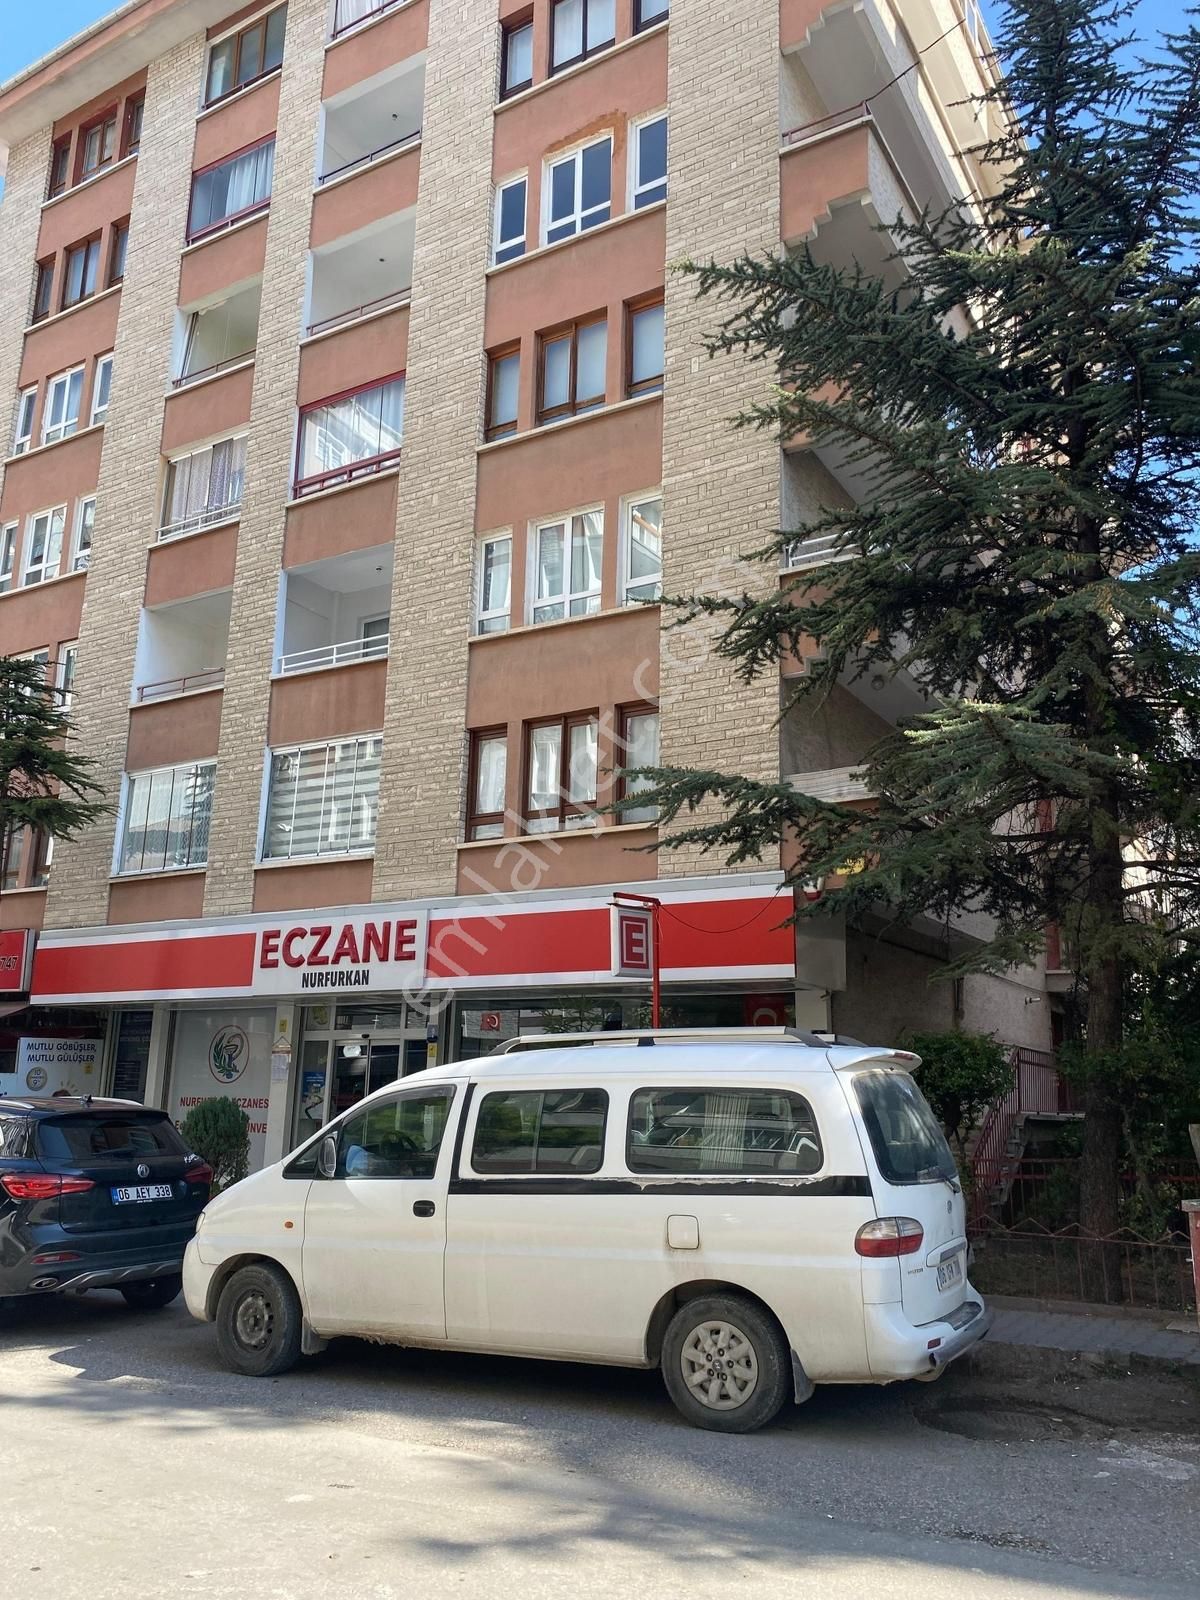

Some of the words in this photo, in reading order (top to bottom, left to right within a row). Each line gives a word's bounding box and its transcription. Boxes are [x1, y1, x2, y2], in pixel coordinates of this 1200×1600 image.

[260, 920, 417, 968] ECZANE
[623, 921, 646, 964] E
[302, 970, 370, 988] NURFURKAN
[27, 1043, 54, 1051] MUTLU
[28, 1054, 54, 1062] MUTLU
[231, 1098, 269, 1109] CZANES
[118, 1189, 130, 1200] 06
[136, 1187, 151, 1199] AEY
[155, 1185, 171, 1197] 338
